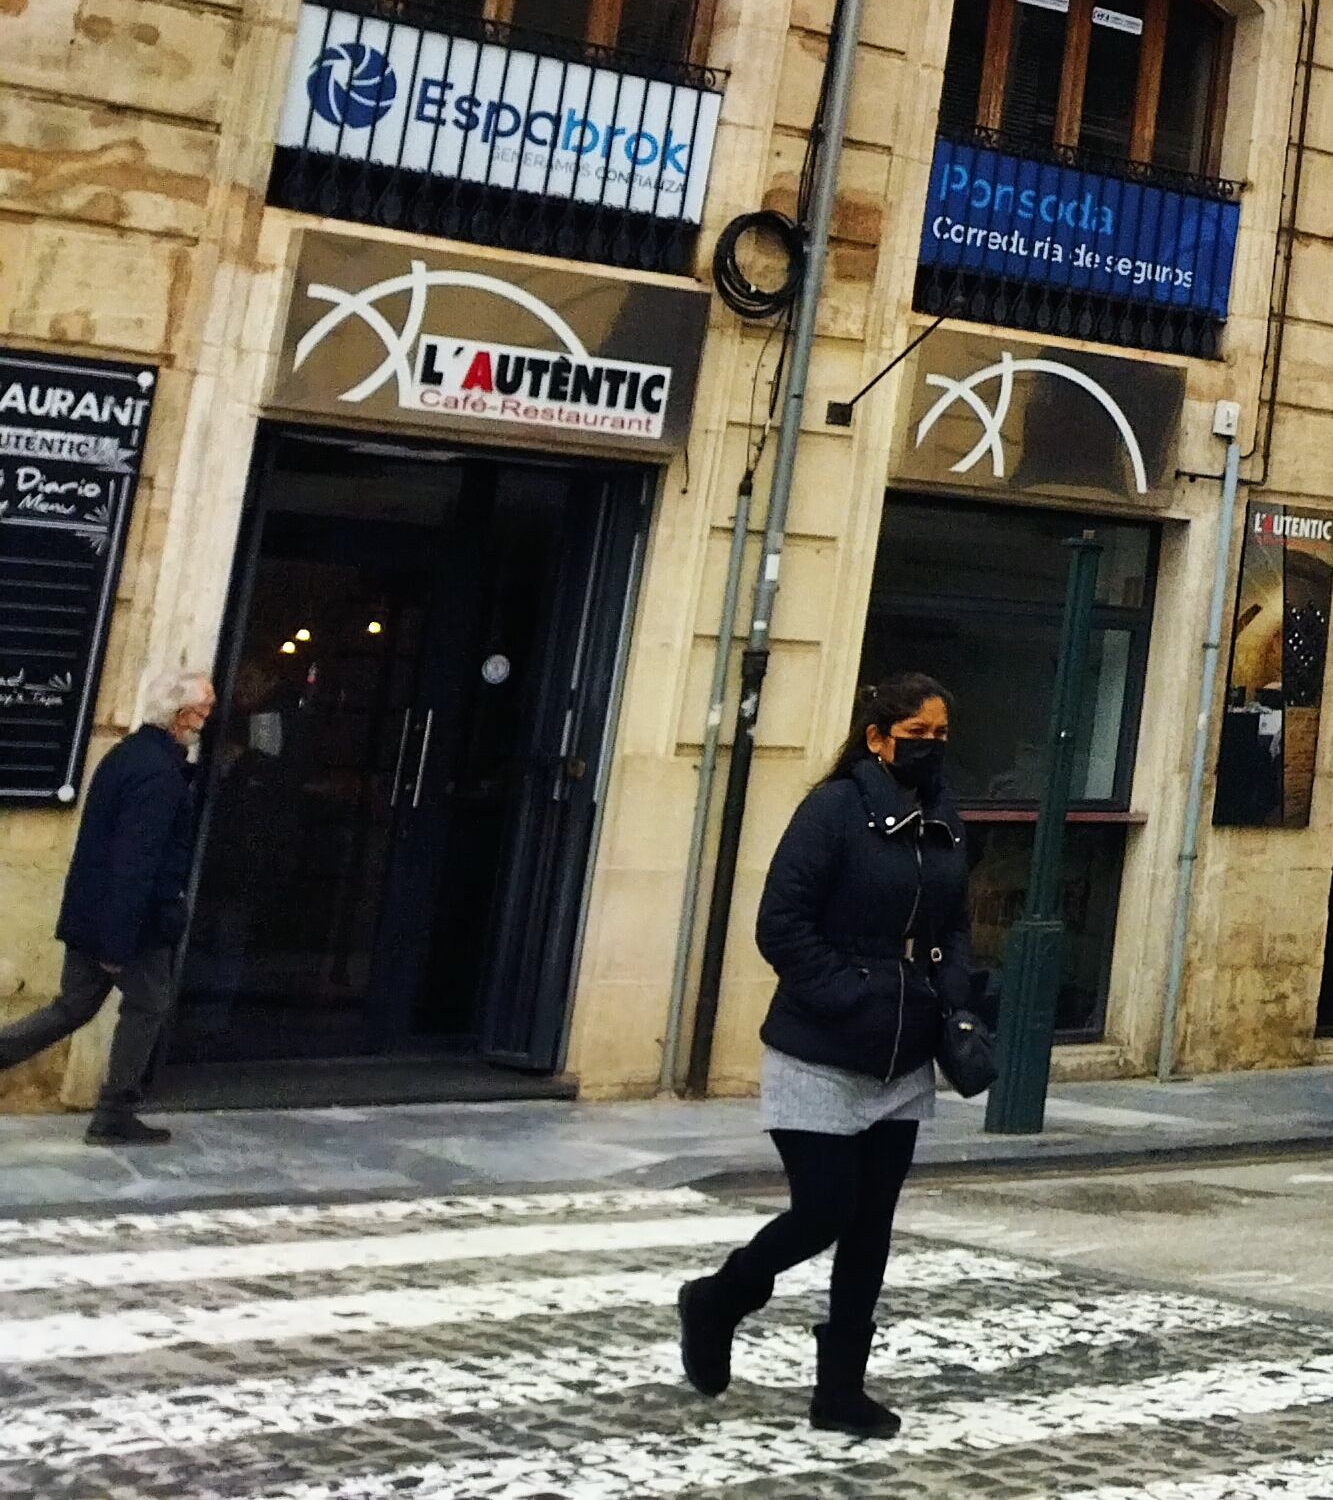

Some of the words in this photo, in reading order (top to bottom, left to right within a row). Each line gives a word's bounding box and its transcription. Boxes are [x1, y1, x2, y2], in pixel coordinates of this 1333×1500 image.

[415, 76, 688, 176] Espabrok
[1069, 243, 1100, 269] de
[1105, 253, 1194, 289] seguros
[419, 388, 653, 434] Café-Restaurant
